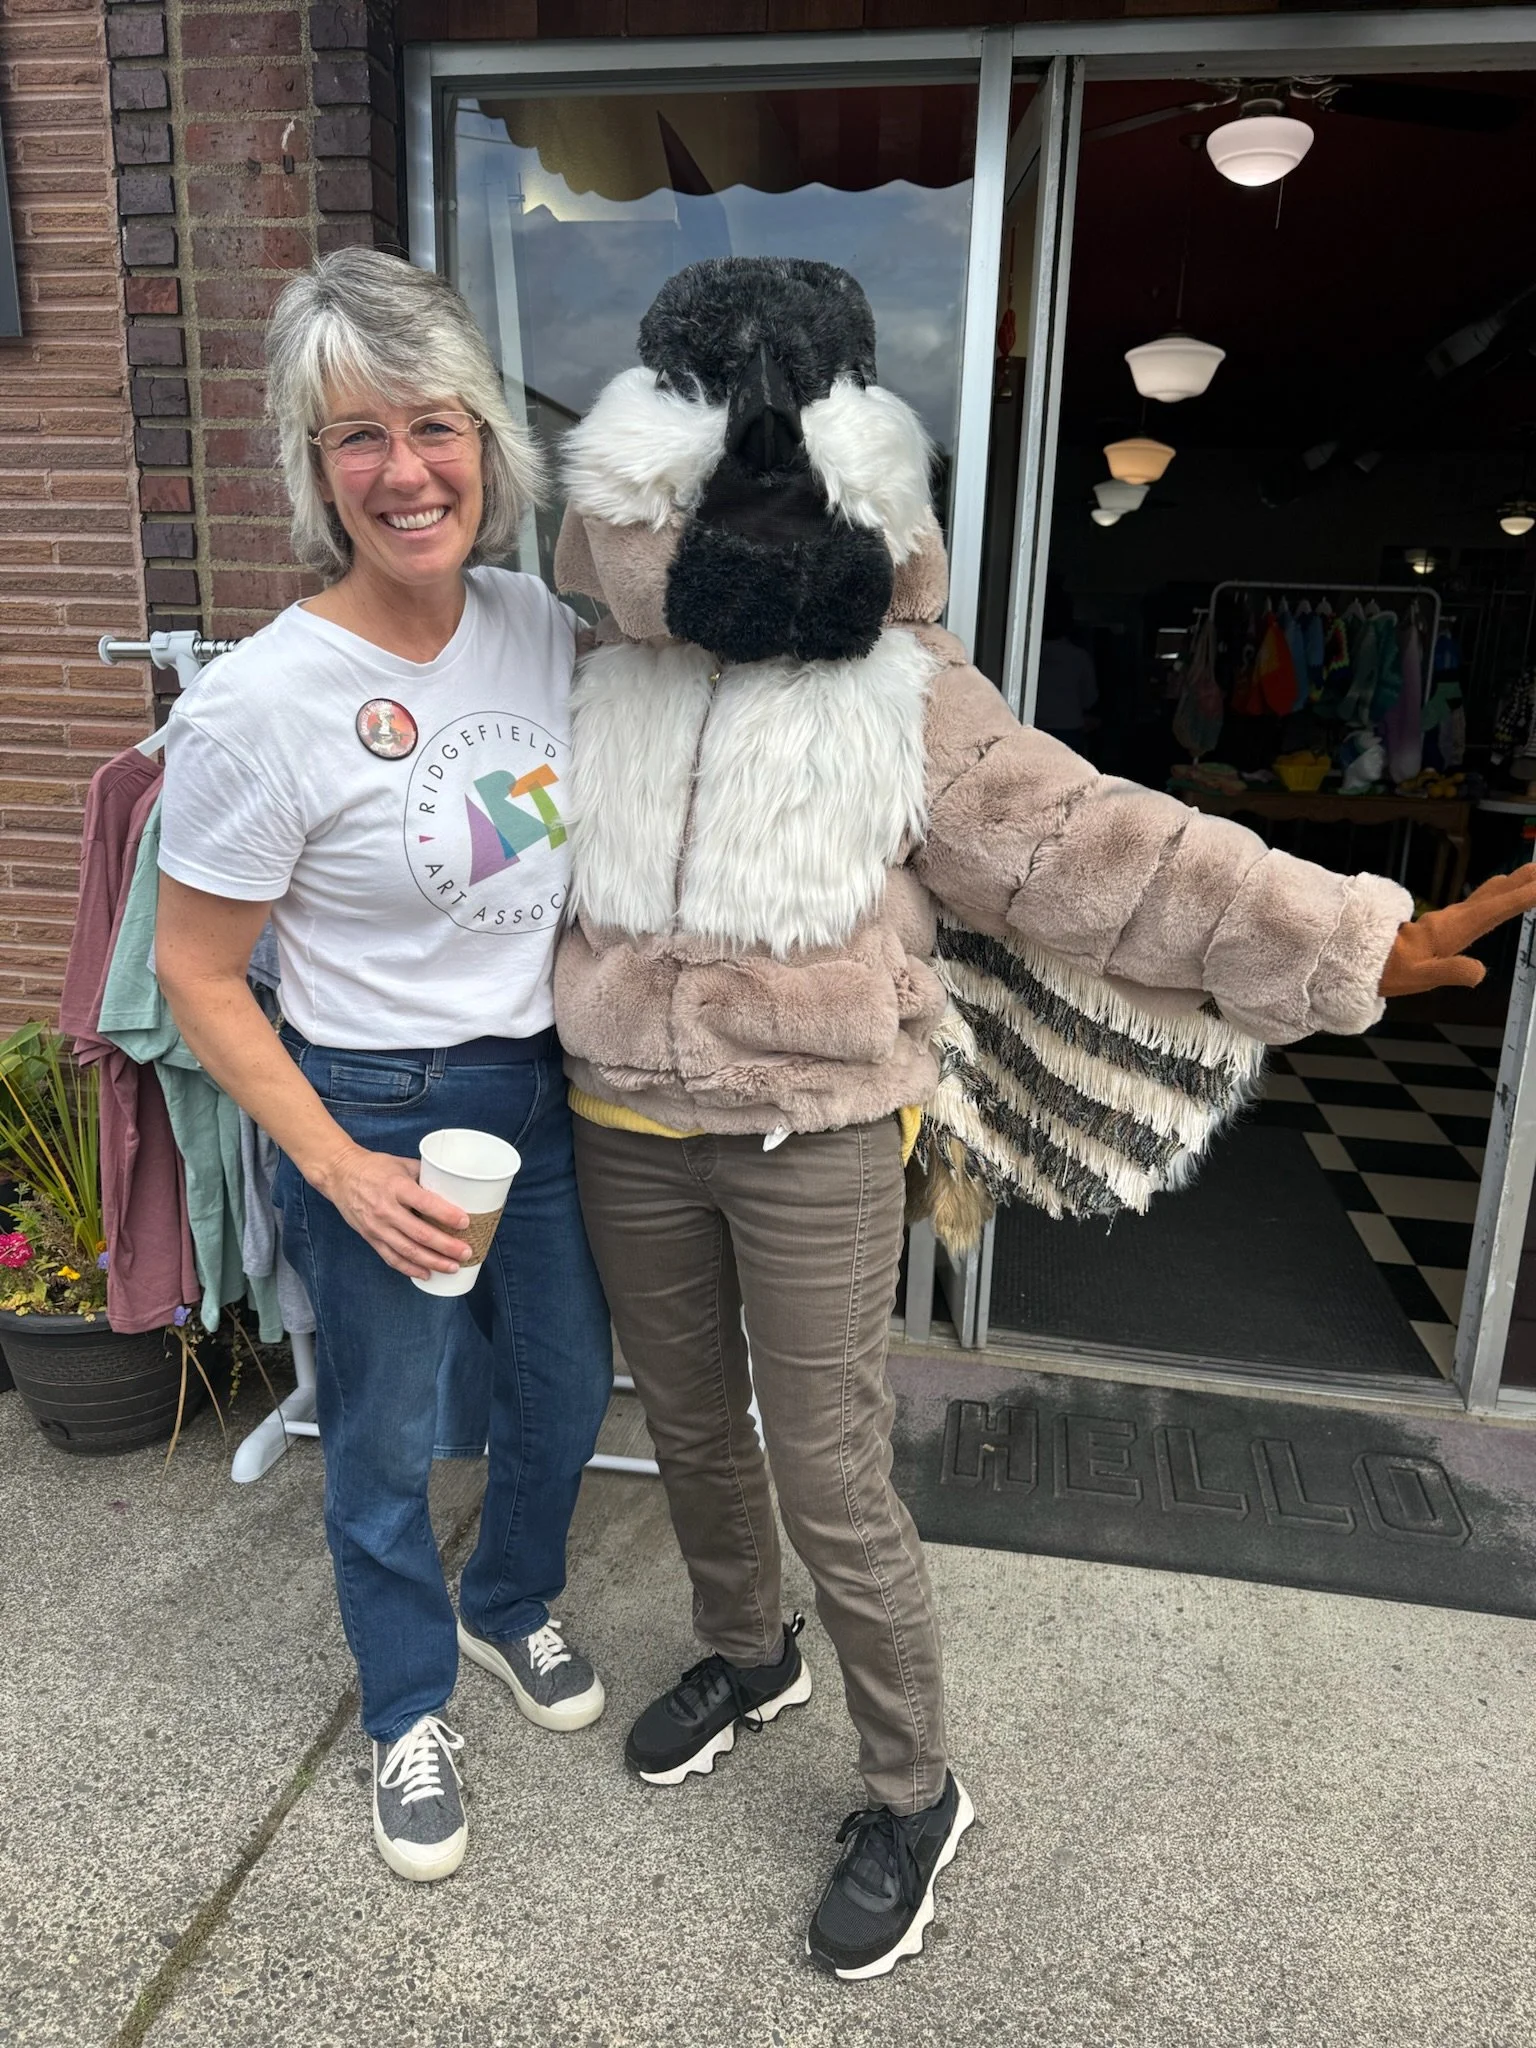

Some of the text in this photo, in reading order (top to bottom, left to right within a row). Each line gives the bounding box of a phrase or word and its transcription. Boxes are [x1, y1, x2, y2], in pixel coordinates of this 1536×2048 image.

[419, 723, 556, 814] RIDGEFIELD
[424, 864, 467, 905] ART
[941, 1399, 1473, 1546] HELLO
